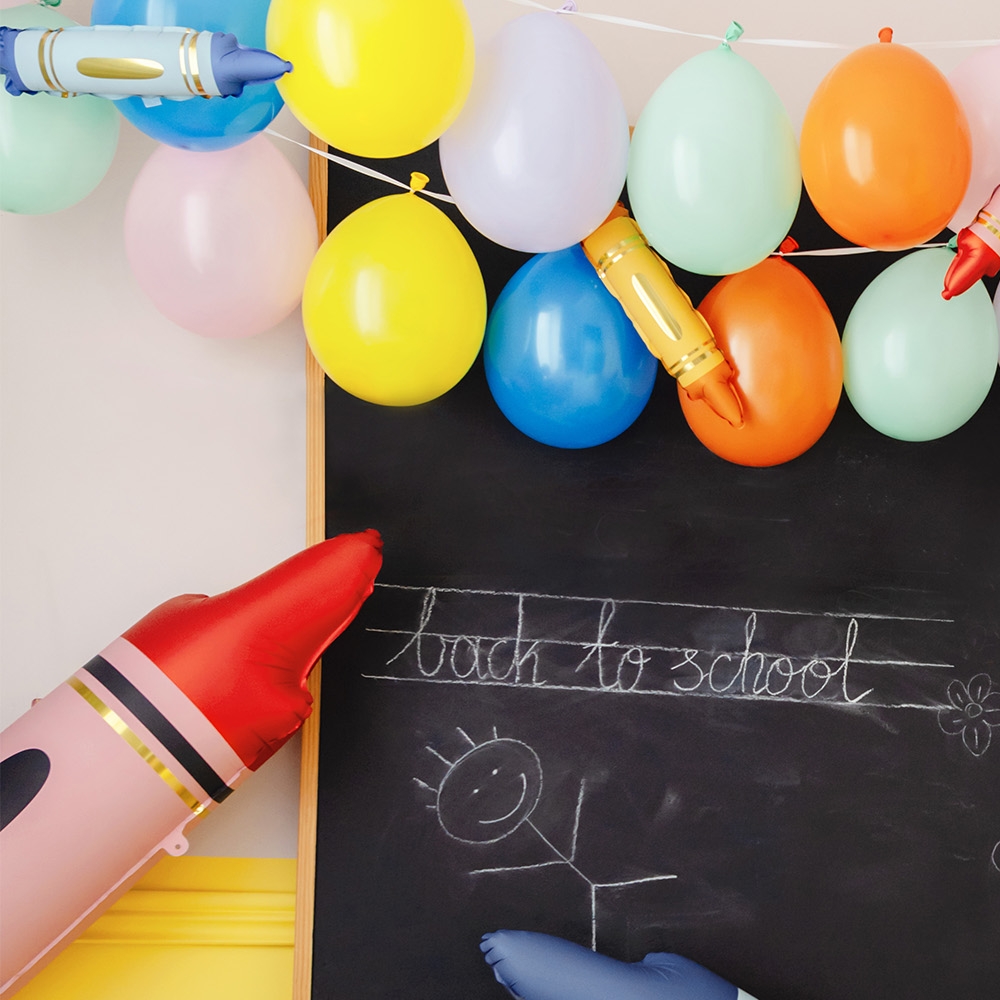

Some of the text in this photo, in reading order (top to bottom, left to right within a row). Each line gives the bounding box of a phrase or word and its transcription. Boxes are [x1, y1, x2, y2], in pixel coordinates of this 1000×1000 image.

[385, 586, 875, 704] back to school
